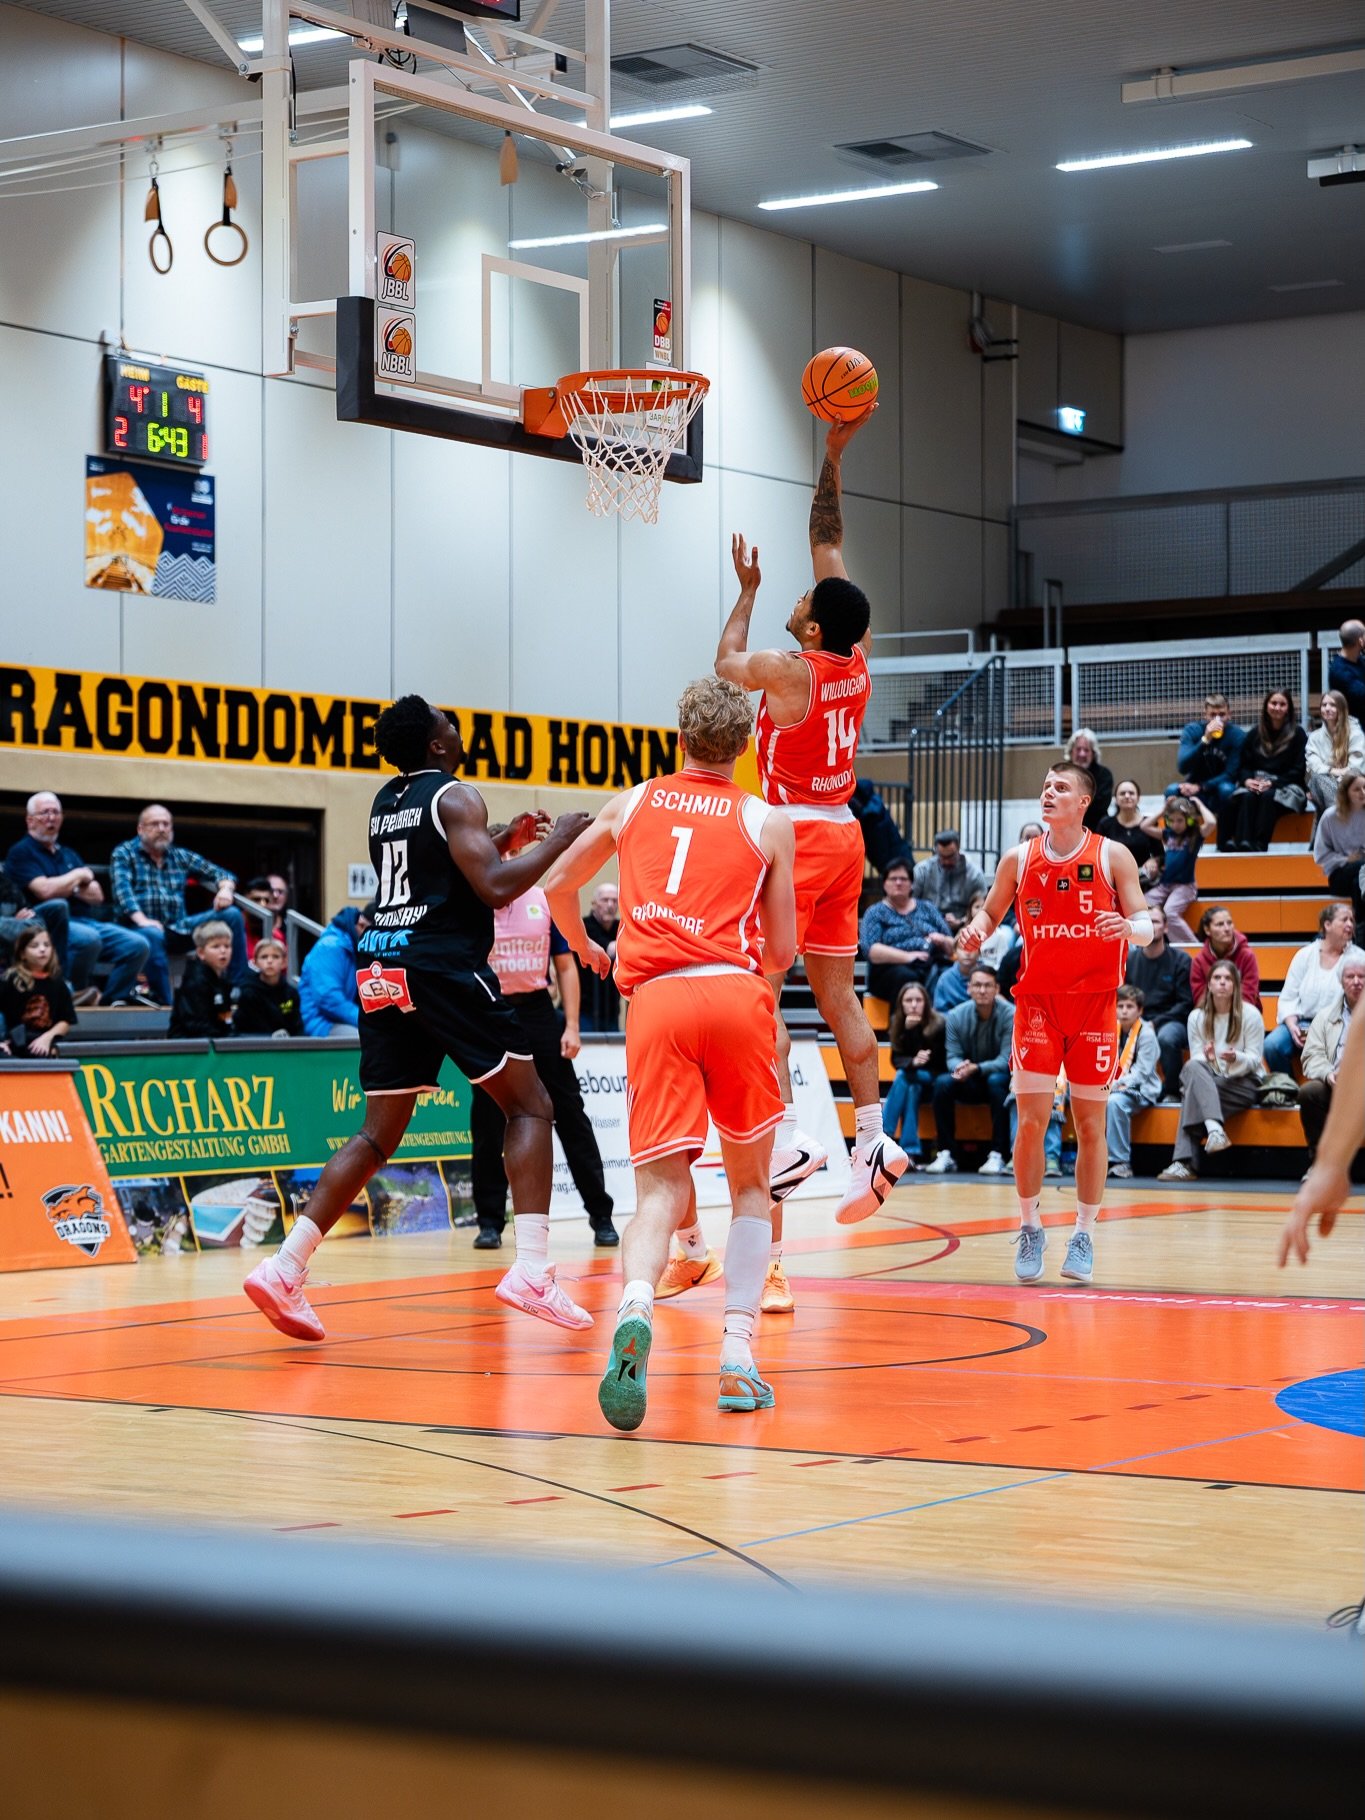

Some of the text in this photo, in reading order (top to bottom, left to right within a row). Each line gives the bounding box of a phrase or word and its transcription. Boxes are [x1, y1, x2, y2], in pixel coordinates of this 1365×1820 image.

[382, 277, 409, 301] JBBL
[654, 335, 671, 349] DBB
[381, 352, 411, 376] NBBL
[129, 385, 201, 424] 4 1 4
[114, 416, 128, 447] 2
[147, 422, 188, 458] 6:43
[823, 707, 857, 767] 14
[651, 789, 732, 817] SCHMID
[378, 839, 411, 908] 12
[665, 825, 694, 895] 1
[1079, 890, 1093, 915] 5
[490, 957, 544, 973] UTOGLAS
[1095, 1045, 1111, 1072] 5
[80, 1064, 286, 1138] RICHARZ
[332, 1077, 362, 1113] Wir
[0, 1110, 73, 1144] KANN!
[98, 1133, 291, 1164] GARTENGESTALTUNG GMBH
[57, 1221, 108, 1238] DRAGONS
